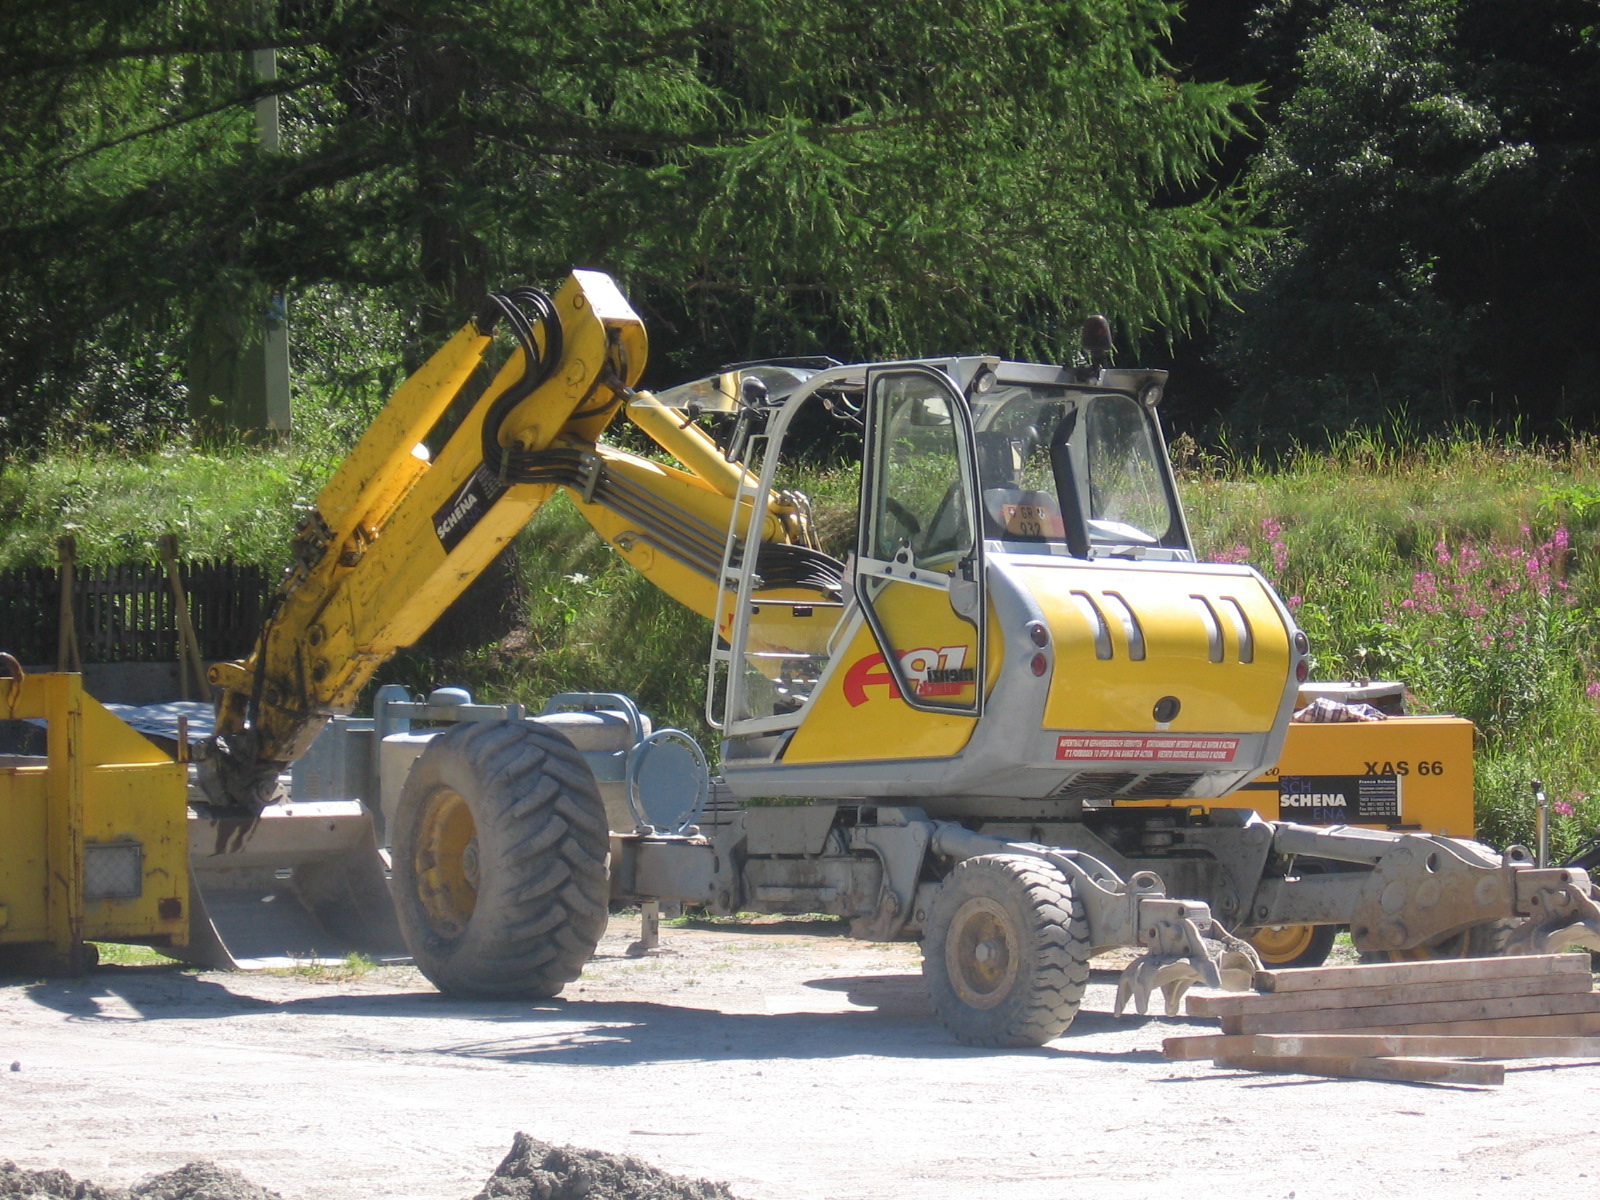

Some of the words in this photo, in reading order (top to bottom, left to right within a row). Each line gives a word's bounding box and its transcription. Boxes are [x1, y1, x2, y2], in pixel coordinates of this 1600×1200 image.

[437, 493, 477, 539] SCHENA
[1021, 506, 1033, 519] GR
[1364, 762, 1410, 776] XAS
[1418, 761, 1443, 776] 66
[1280, 793, 1347, 807] SCHENA
